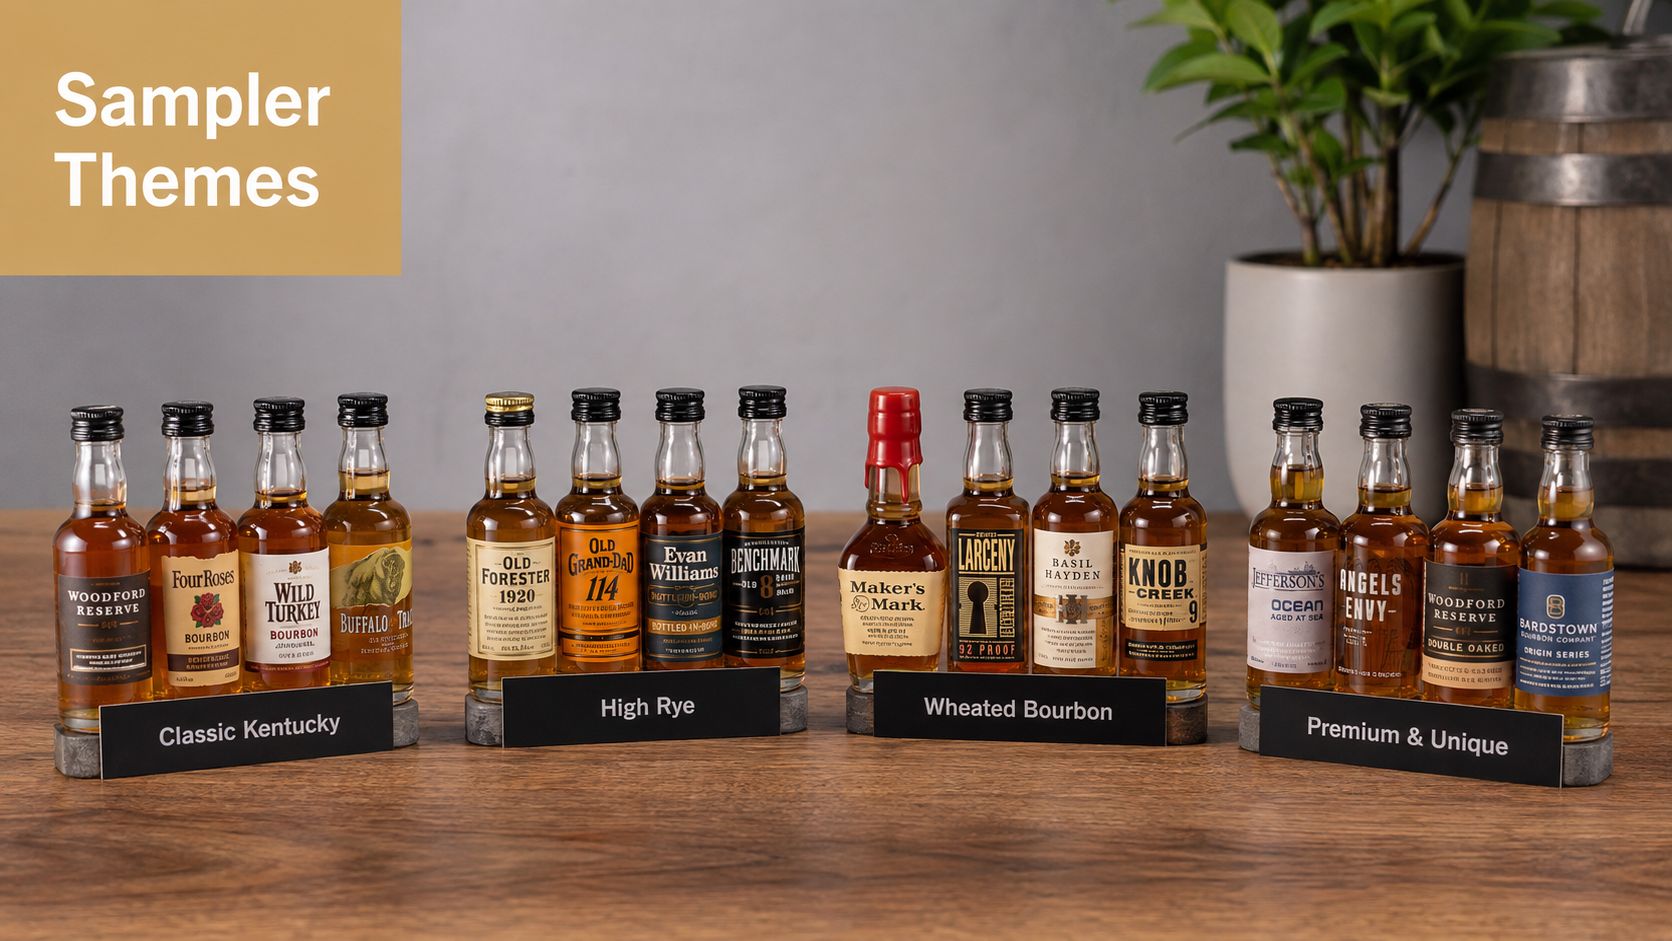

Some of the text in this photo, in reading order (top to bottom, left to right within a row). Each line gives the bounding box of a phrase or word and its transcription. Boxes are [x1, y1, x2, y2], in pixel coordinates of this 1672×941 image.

[589, 538, 615, 555] OLD
[663, 546, 708, 563] Evan
[958, 538, 1016, 572] LARCENY
[503, 556, 531, 570] OLD
[567, 552, 634, 577] GRAND-DAD
[731, 546, 800, 574] BENCHMARK
[1052, 558, 1093, 569] BASIL
[172, 569, 235, 589] Four Roses
[482, 568, 550, 586] FORESTER
[649, 562, 719, 581] Williams
[1045, 569, 1101, 580] HAYDEN
[1128, 556, 1187, 588] KNOB
[1252, 567, 1325, 589] JEFFERSON'S
[586, 575, 619, 602] 114
[850, 581, 926, 595] Maker's
[1340, 568, 1402, 596] ANGELS
[67, 588, 146, 603] WOODFORD
[273, 582, 315, 604] WILD
[499, 589, 535, 604] 1920
[1136, 588, 1195, 600] CREEK
[1427, 592, 1506, 610] WOODFORD
[76, 603, 140, 617] RESERVE
[265, 600, 321, 625] TURKEY
[1188, 600, 1199, 624] 9
[1271, 599, 1324, 612] OCEAN
[1345, 597, 1387, 623] ENVY
[340, 612, 388, 634] BUFFALO
[1270, 613, 1324, 622] AGED AT SEA
[1433, 608, 1497, 623] RESERVE
[270, 627, 319, 640] BOURBON
[1519, 617, 1598, 635] BARDSTOWN
[185, 630, 230, 644] BOURBON
[1427, 638, 1505, 653] DOUBLE OAKED
[959, 644, 1015, 655] 92 PROOF
[1523, 646, 1590, 659] ORIGIN SERIES
[601, 696, 695, 720] High Rye
[923, 696, 1113, 721] Wheated Bourbon
[158, 713, 341, 747] Classic Kentucky
[1306, 715, 1509, 757] Premium & Unique
